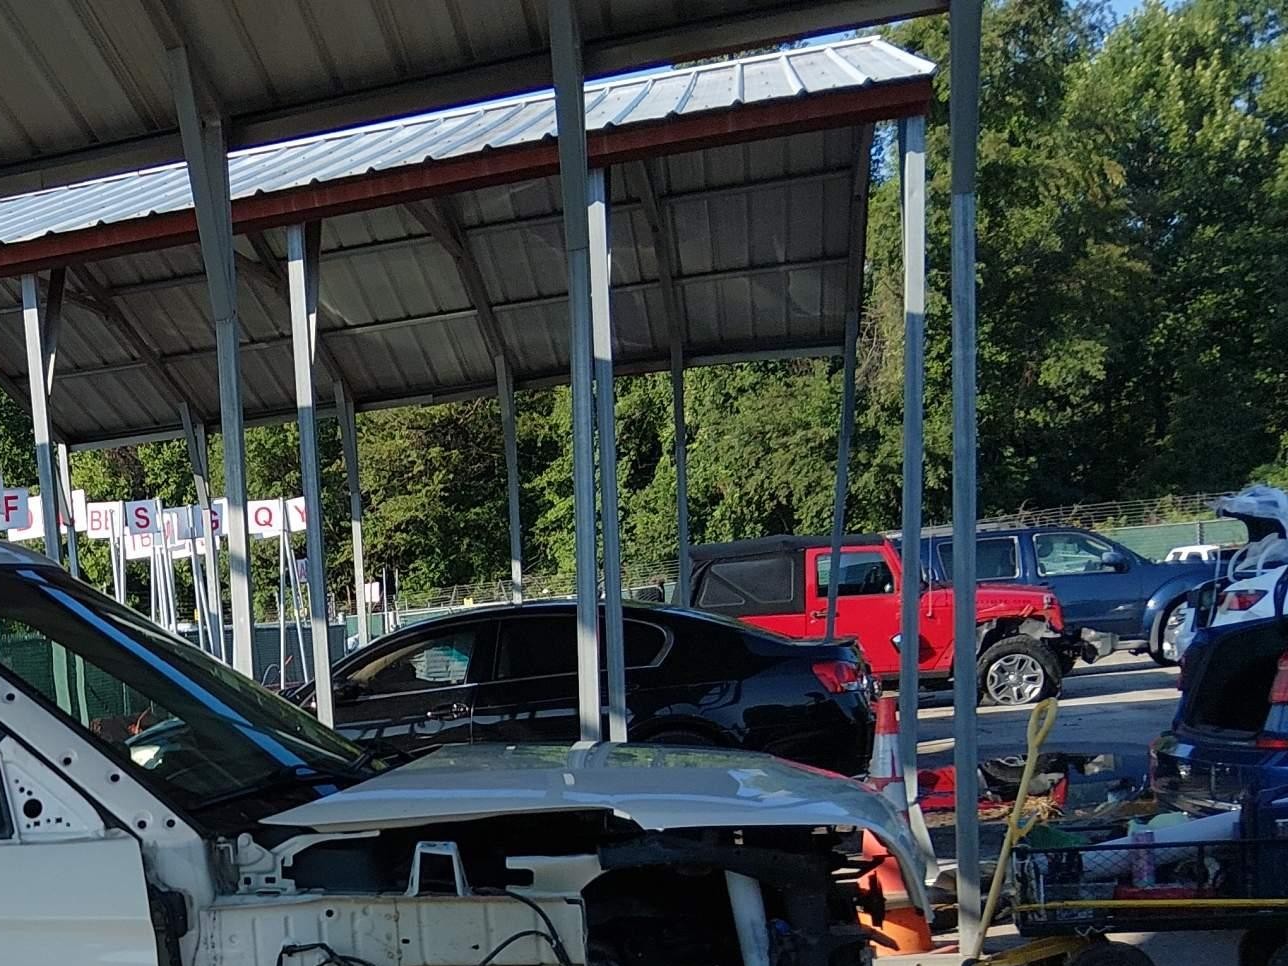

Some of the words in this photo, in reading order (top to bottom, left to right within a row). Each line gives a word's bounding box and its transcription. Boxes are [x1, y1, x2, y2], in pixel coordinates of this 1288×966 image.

[4, 495, 19, 521] F
[134, 506, 151, 528] S
[254, 506, 273, 527] Q
